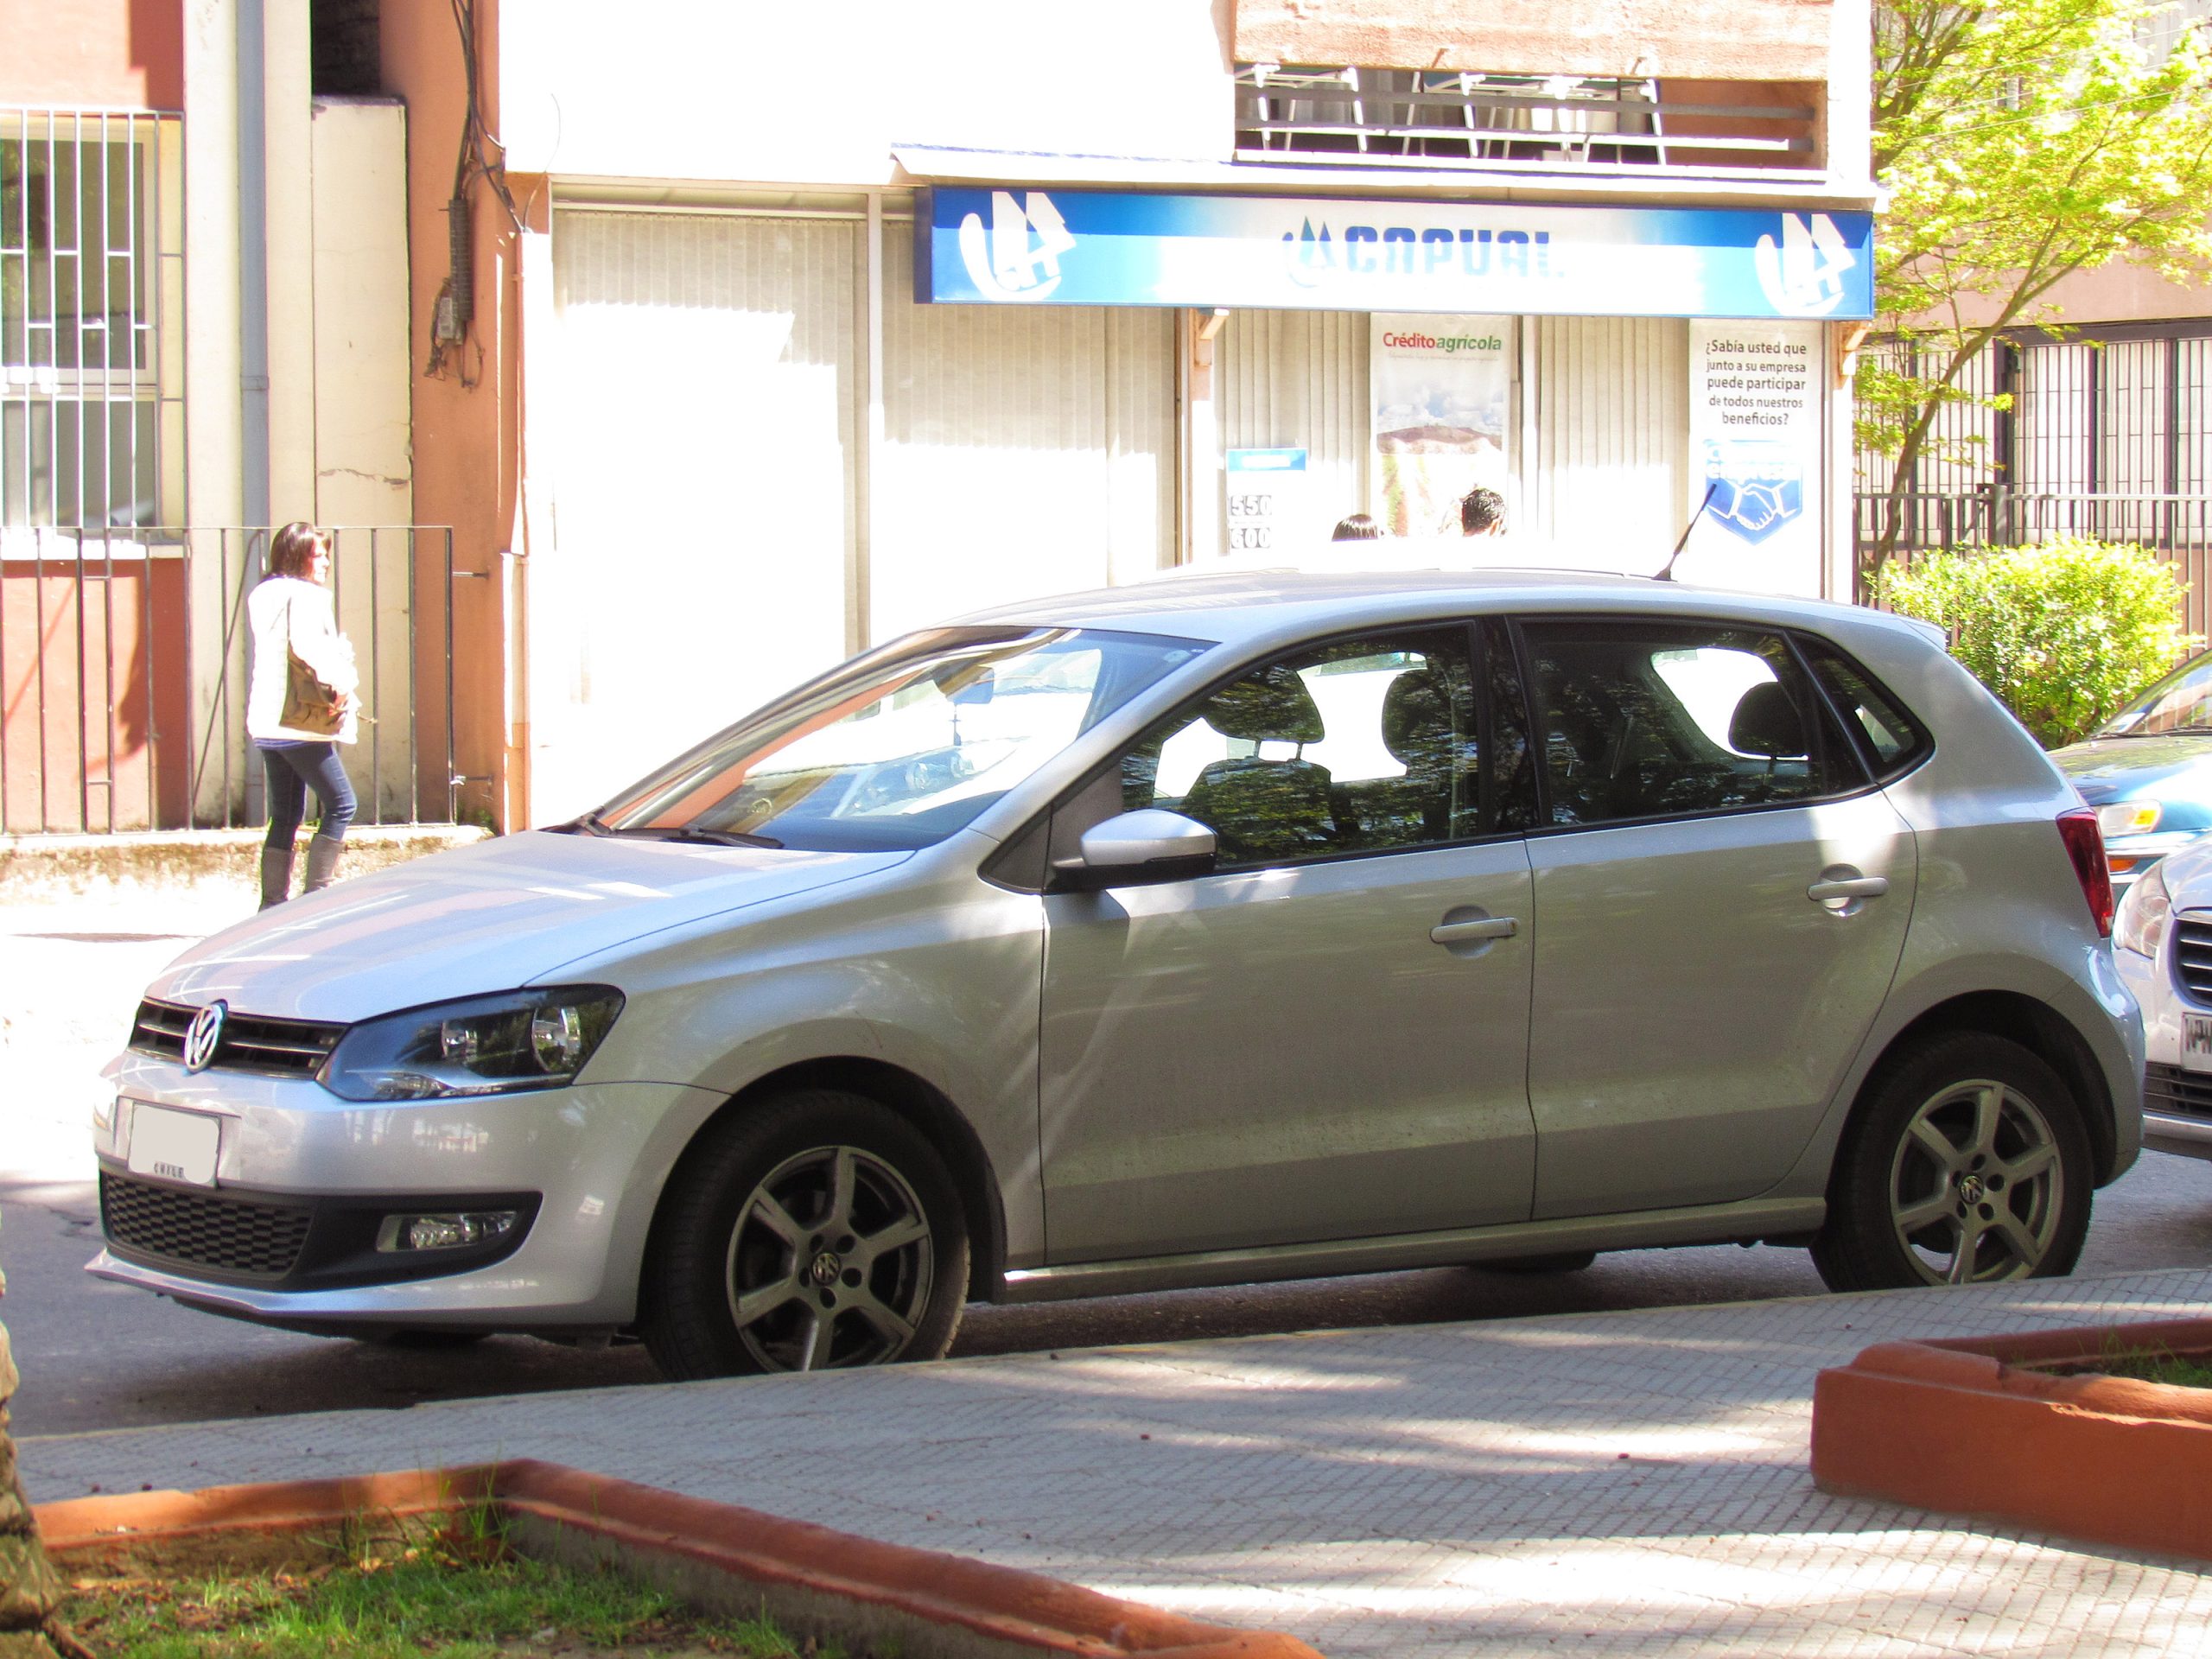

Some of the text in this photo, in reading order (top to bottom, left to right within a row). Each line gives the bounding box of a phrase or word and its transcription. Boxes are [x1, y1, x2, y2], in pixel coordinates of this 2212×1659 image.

[1706, 340, 1807, 357] ¿Sabía usted que
[1706, 359, 1734, 372] junto
[1745, 362, 1757, 372] su
[1759, 363, 1806, 375] empresa
[1707, 375, 1806, 393] puede participar
[1709, 395, 1803, 408] de todos nuestros
[1722, 411, 1789, 425] beneficios?
